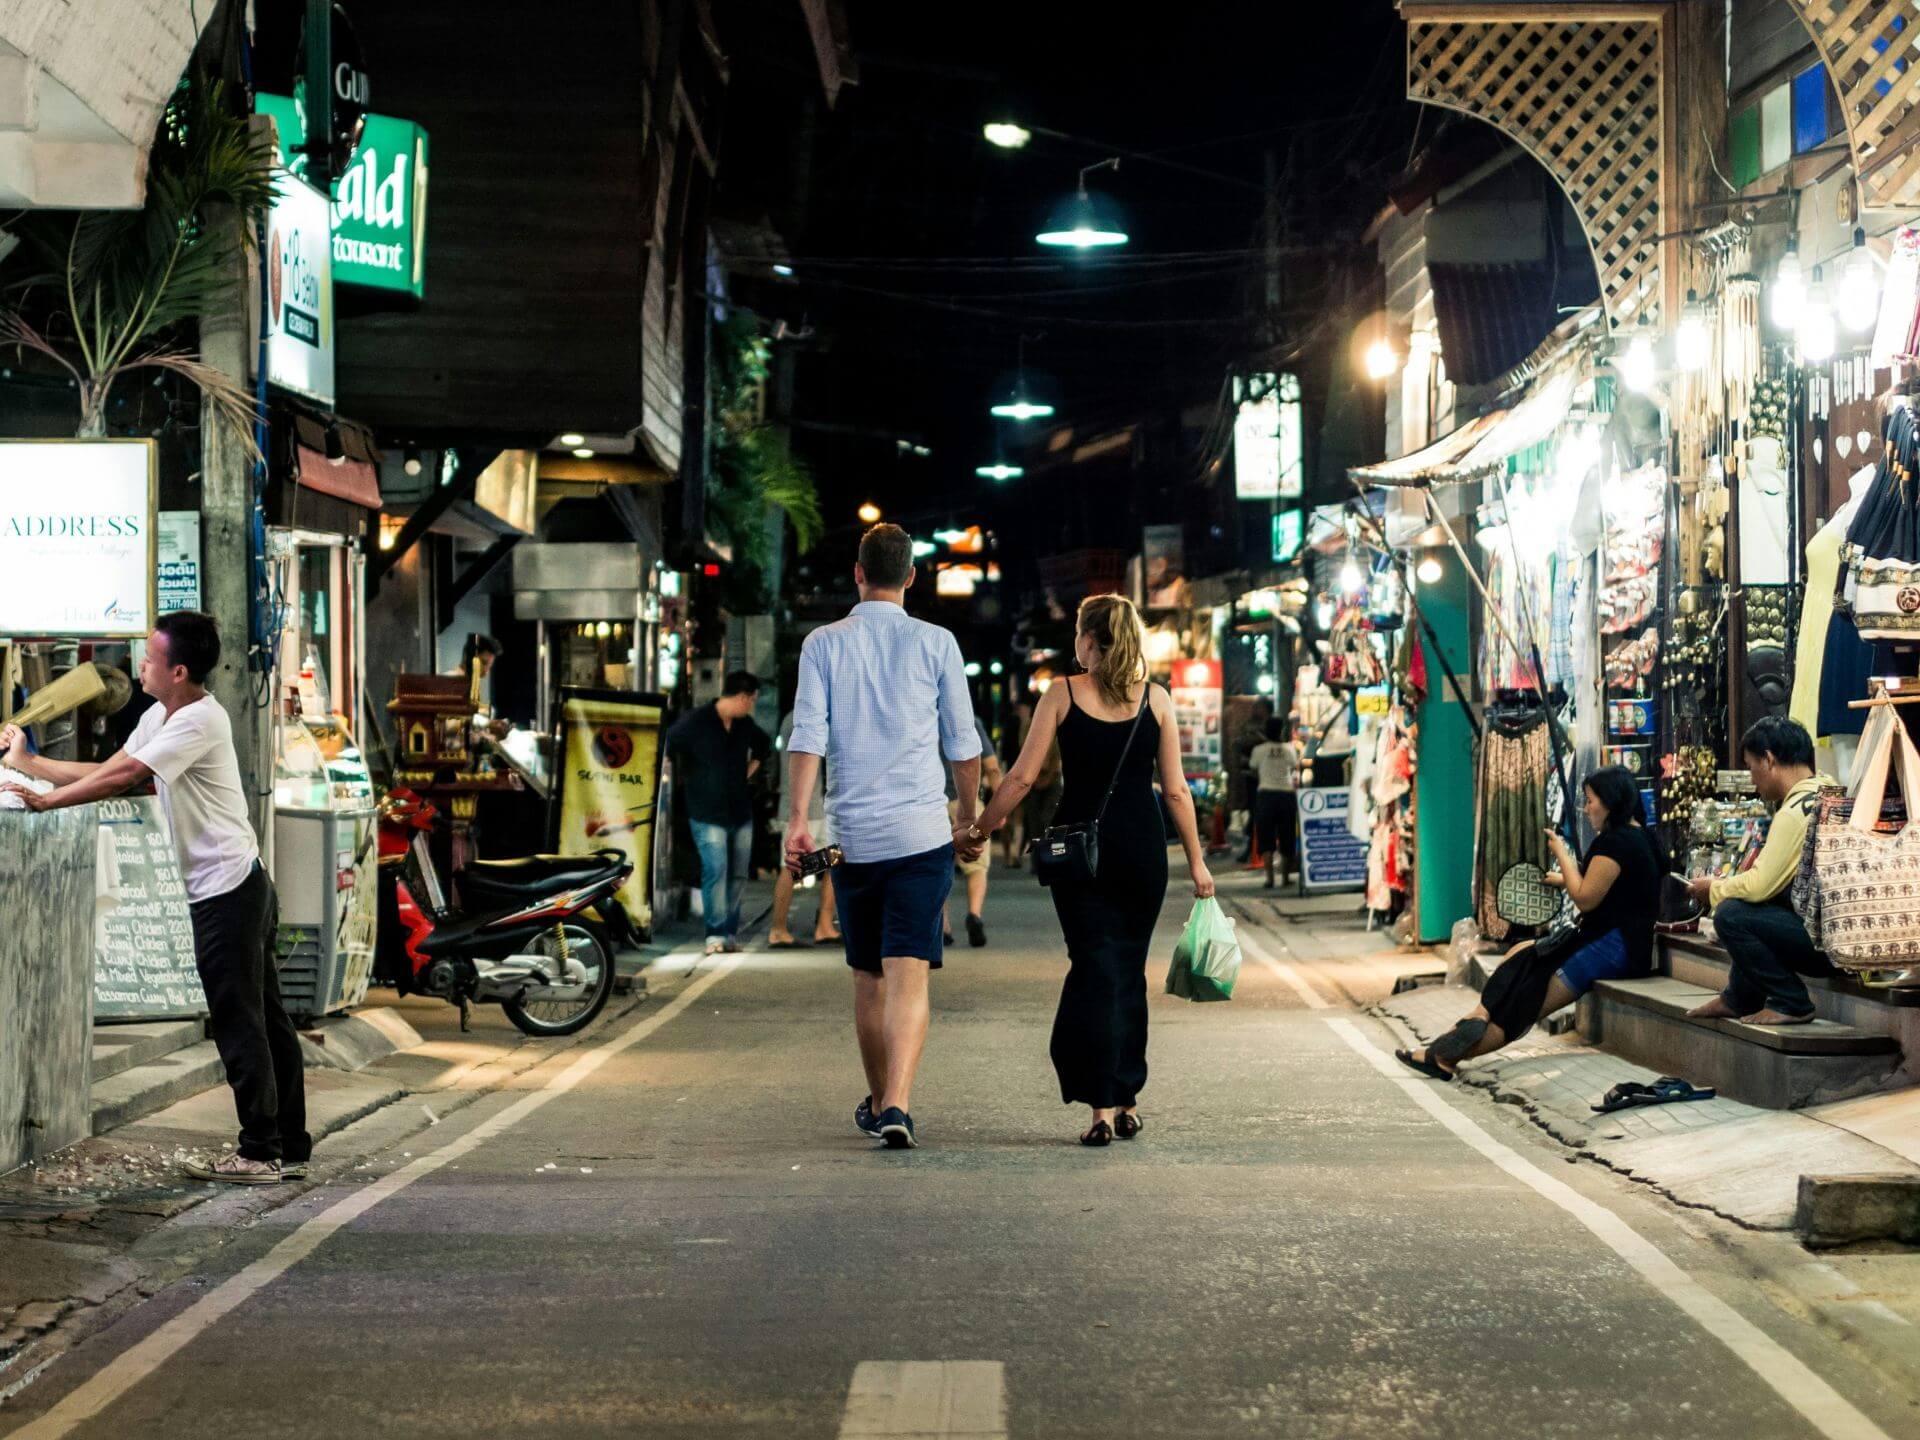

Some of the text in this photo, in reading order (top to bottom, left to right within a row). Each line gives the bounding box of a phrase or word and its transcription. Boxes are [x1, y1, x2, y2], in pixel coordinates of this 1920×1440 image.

[3, 514, 139, 537] ADDRESS
[619, 773, 644, 786] BAR
[131, 919, 167, 936] Chicken
[134, 935, 169, 952] Chicken
